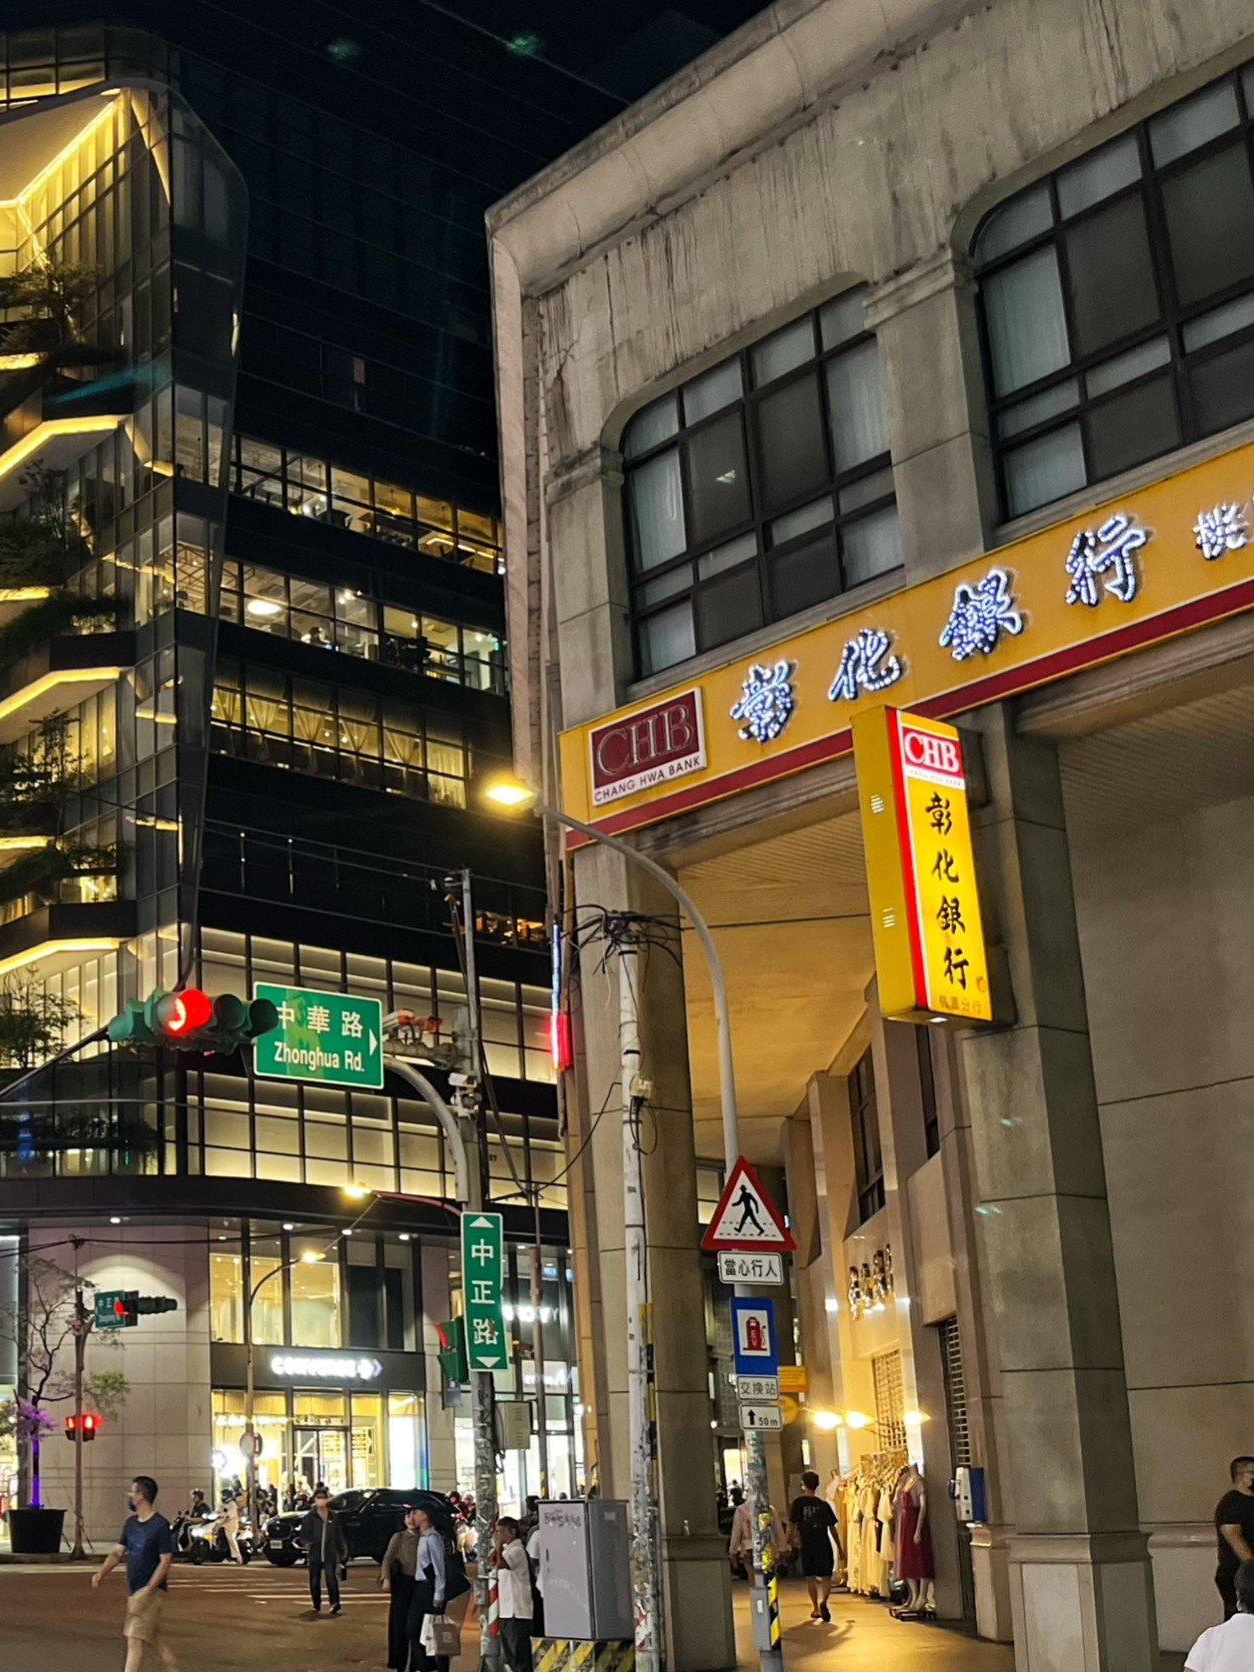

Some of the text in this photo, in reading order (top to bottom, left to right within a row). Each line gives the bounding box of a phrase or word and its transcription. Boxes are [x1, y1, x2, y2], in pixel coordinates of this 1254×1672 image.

[597, 704, 695, 777] CHB
[904, 731, 960, 773] CHB
[594, 755, 700, 803] CHANG HWA BANK
[924, 791, 969, 990] 彰化銀行
[276, 1000, 364, 1039] 中華路
[274, 1041, 365, 1072] Zhonghua Rd.
[723, 1258, 778, 1278] 當心行人
[471, 1238, 499, 1345] 中正路
[739, 1380, 777, 1396] 交換站
